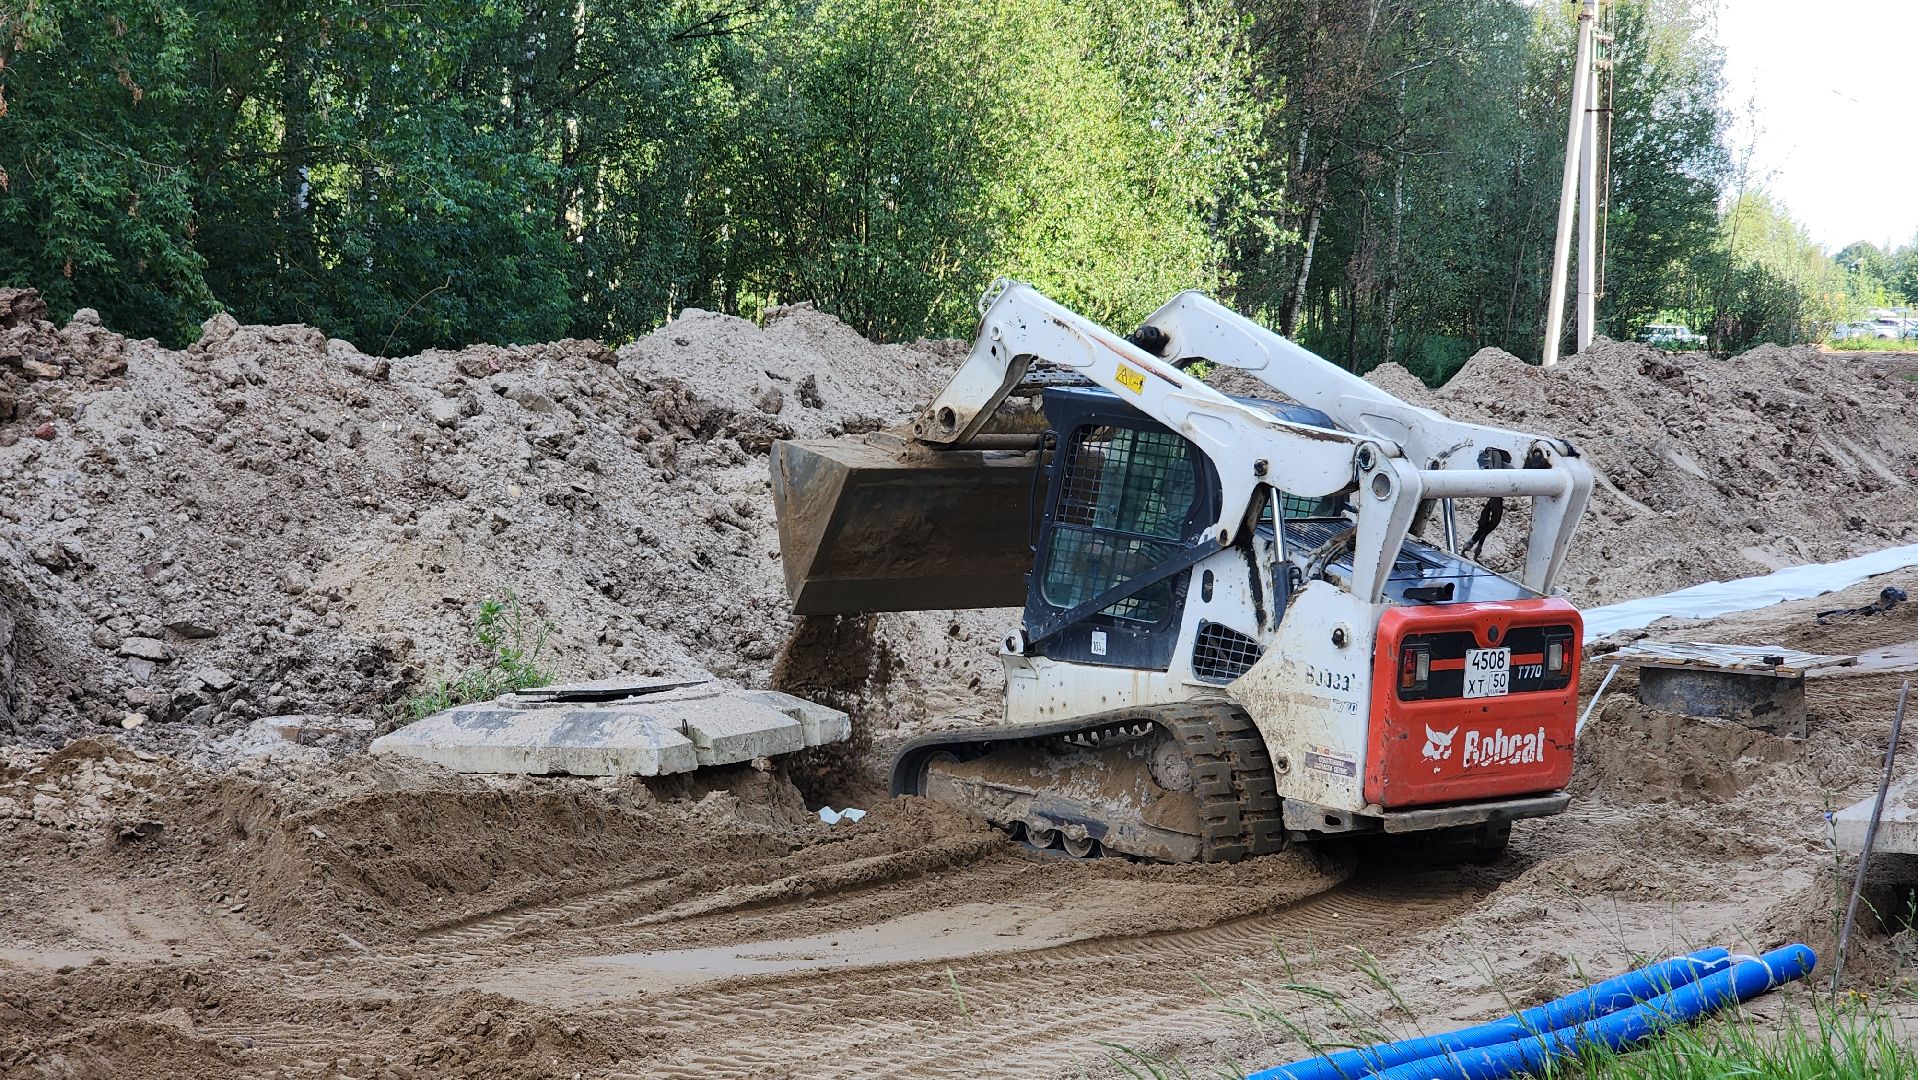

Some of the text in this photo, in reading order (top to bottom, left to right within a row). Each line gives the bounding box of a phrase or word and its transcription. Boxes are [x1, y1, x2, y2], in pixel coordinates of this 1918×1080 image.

[1472, 650, 1505, 670] 4508
[1493, 673, 1506, 688] 50
[1518, 664, 1543, 680] T770
[1463, 726, 1546, 768] Bobcat
